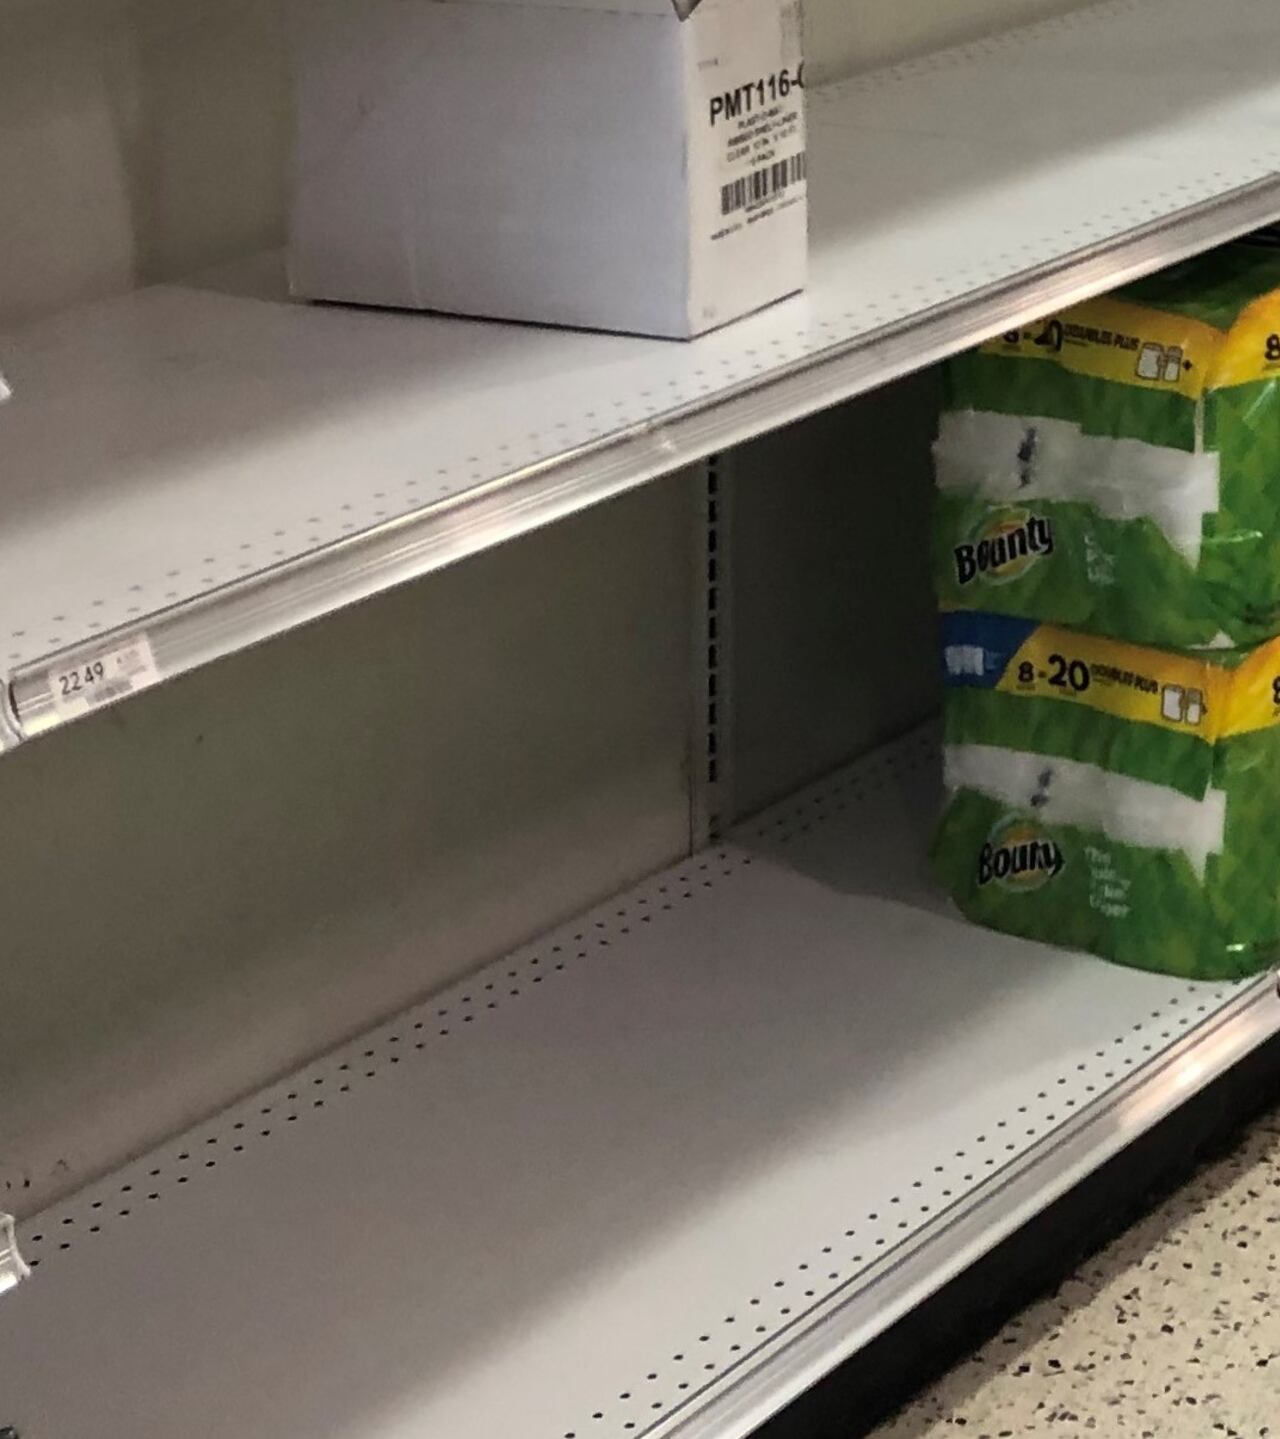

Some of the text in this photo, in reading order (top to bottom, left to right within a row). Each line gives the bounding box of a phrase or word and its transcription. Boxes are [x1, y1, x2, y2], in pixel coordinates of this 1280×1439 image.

[954, 515, 1054, 585] Bounty
[1018, 661, 1035, 683] 8
[1048, 653, 1090, 692] 20
[977, 841, 1063, 886] Bouny
